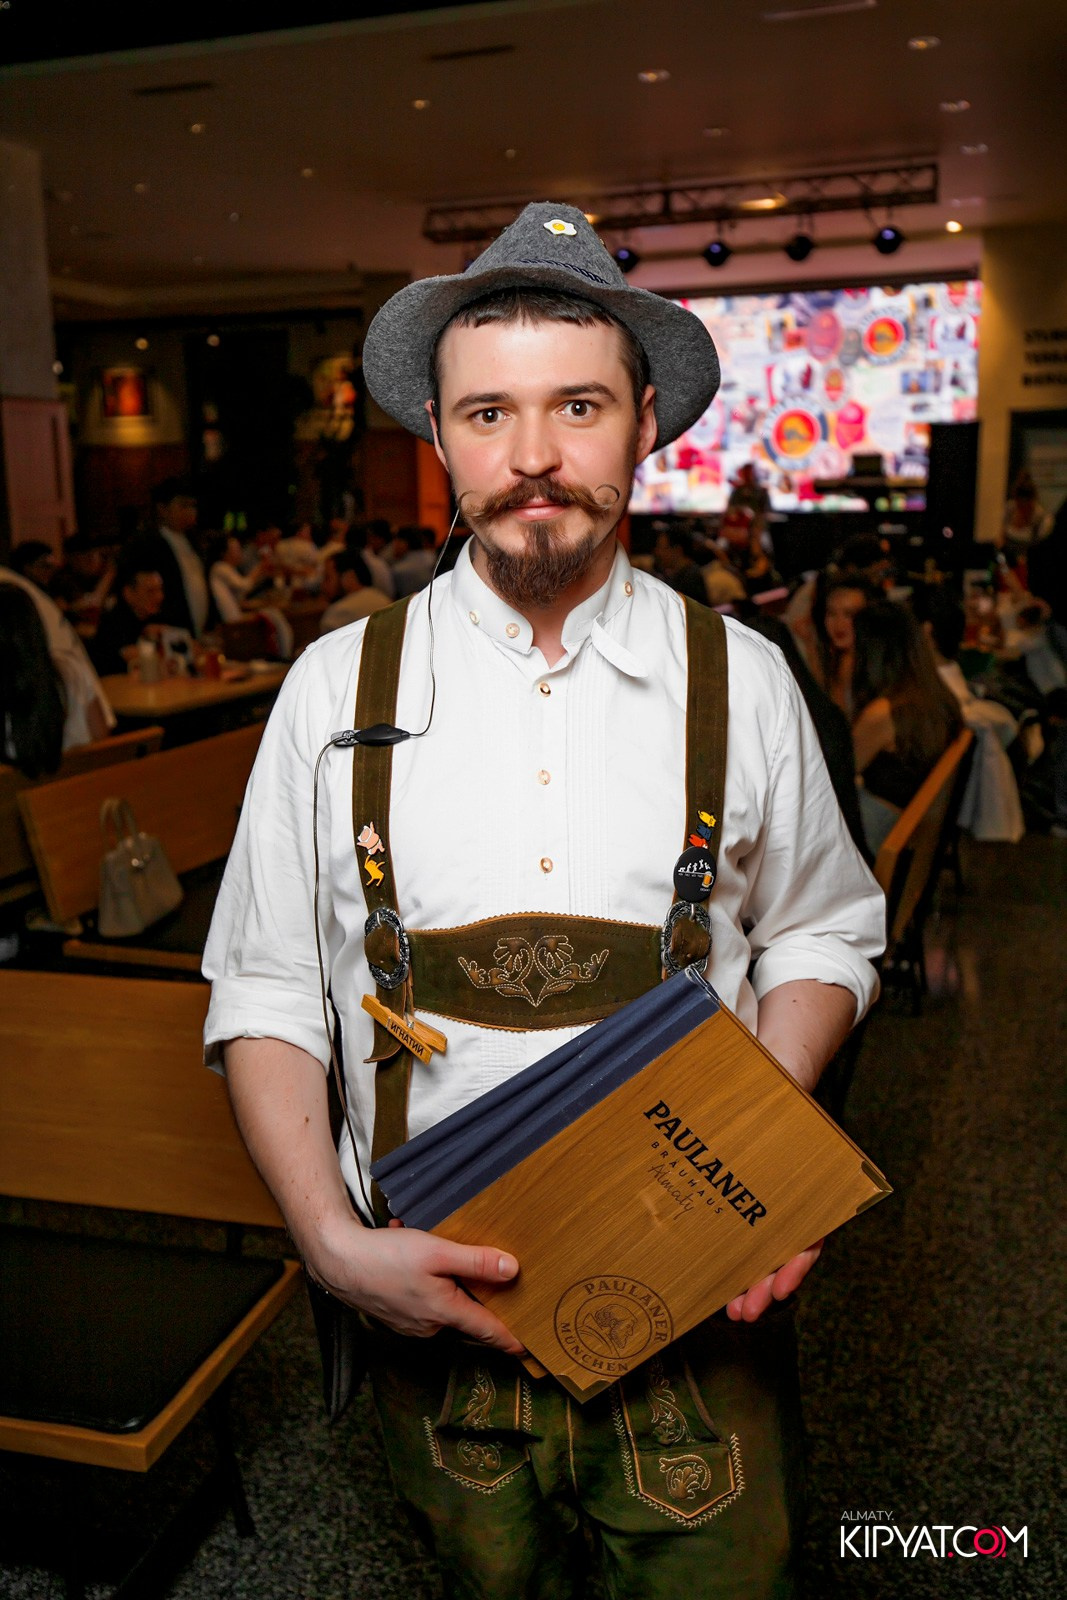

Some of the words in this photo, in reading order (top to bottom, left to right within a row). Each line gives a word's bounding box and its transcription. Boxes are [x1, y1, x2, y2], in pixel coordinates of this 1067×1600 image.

[643, 1100, 767, 1226] PAULANER
[648, 1164, 694, 1220] Almaty
[583, 1280, 668, 1343] PAULANER
